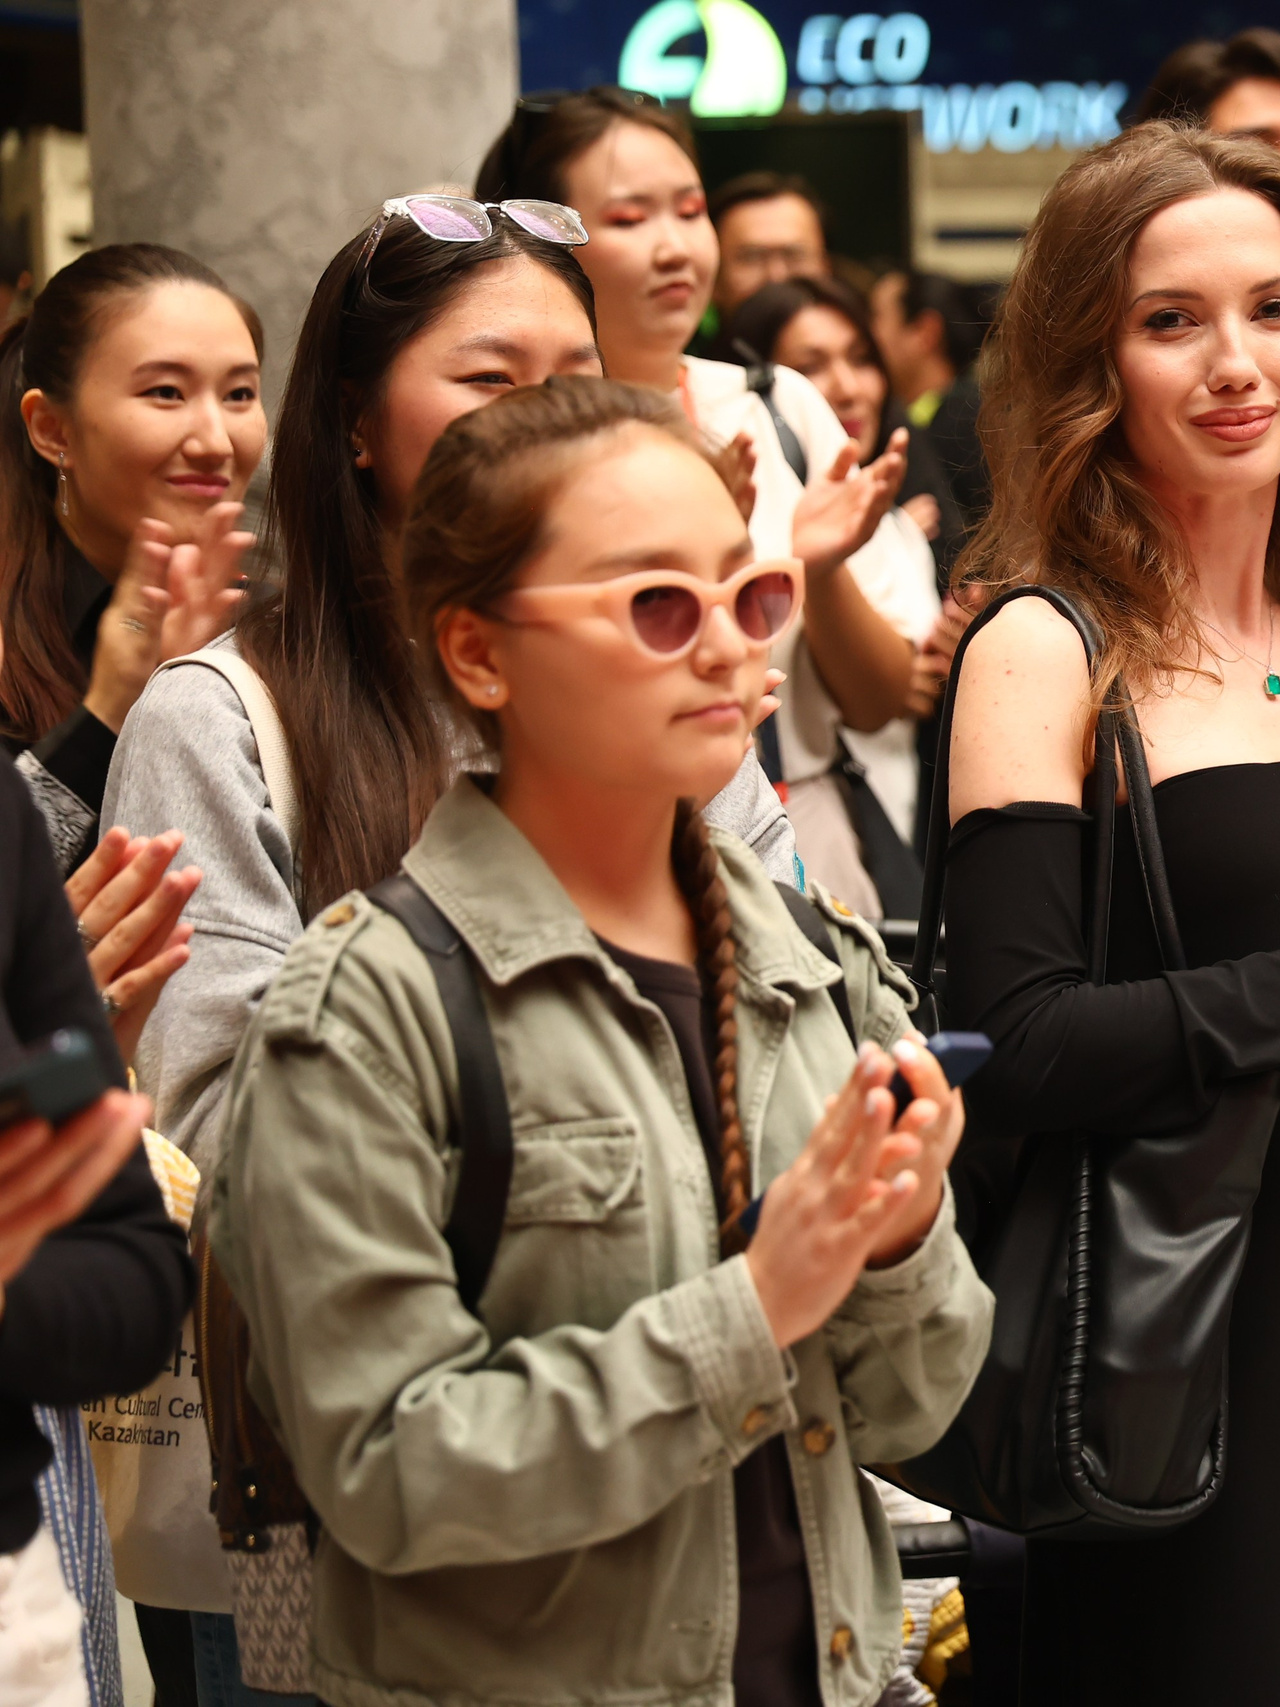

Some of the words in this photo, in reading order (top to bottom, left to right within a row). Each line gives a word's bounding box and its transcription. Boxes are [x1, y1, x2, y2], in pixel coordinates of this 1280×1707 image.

[796, 12, 931, 85] ECO
[115, 1394, 162, 1417] Cultural
[88, 1420, 180, 1447] Kazakhstan
